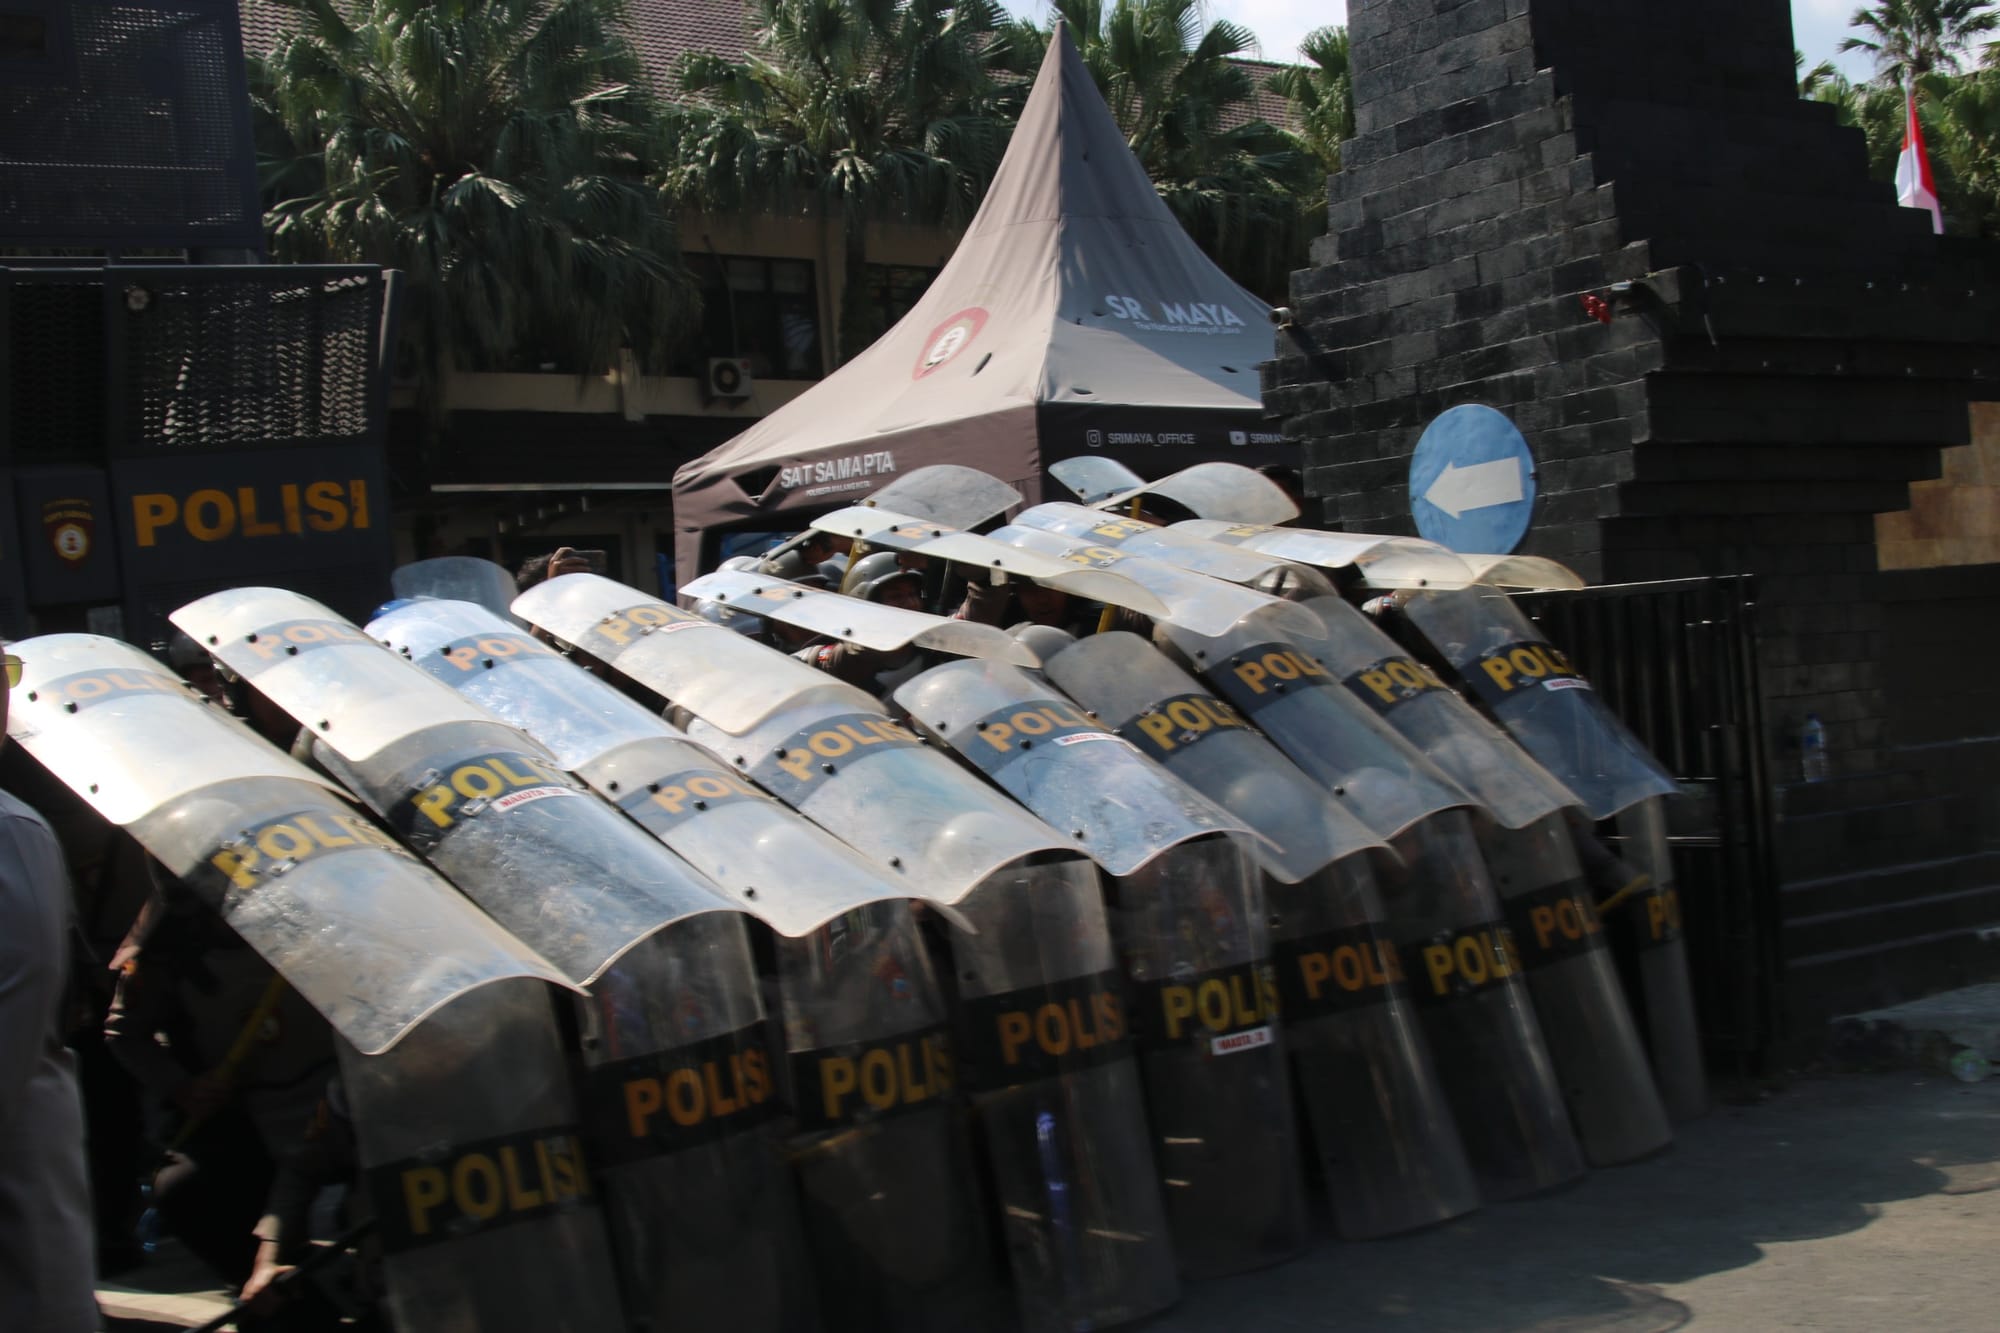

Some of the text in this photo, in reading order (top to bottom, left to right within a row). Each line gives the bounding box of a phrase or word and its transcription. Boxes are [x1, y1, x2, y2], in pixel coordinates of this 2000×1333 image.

[1107, 432, 1196, 446] SRIMAYA_OFFICE
[781, 451, 895, 488] SAT SAMAPTA
[132, 479, 371, 547] POLISI
